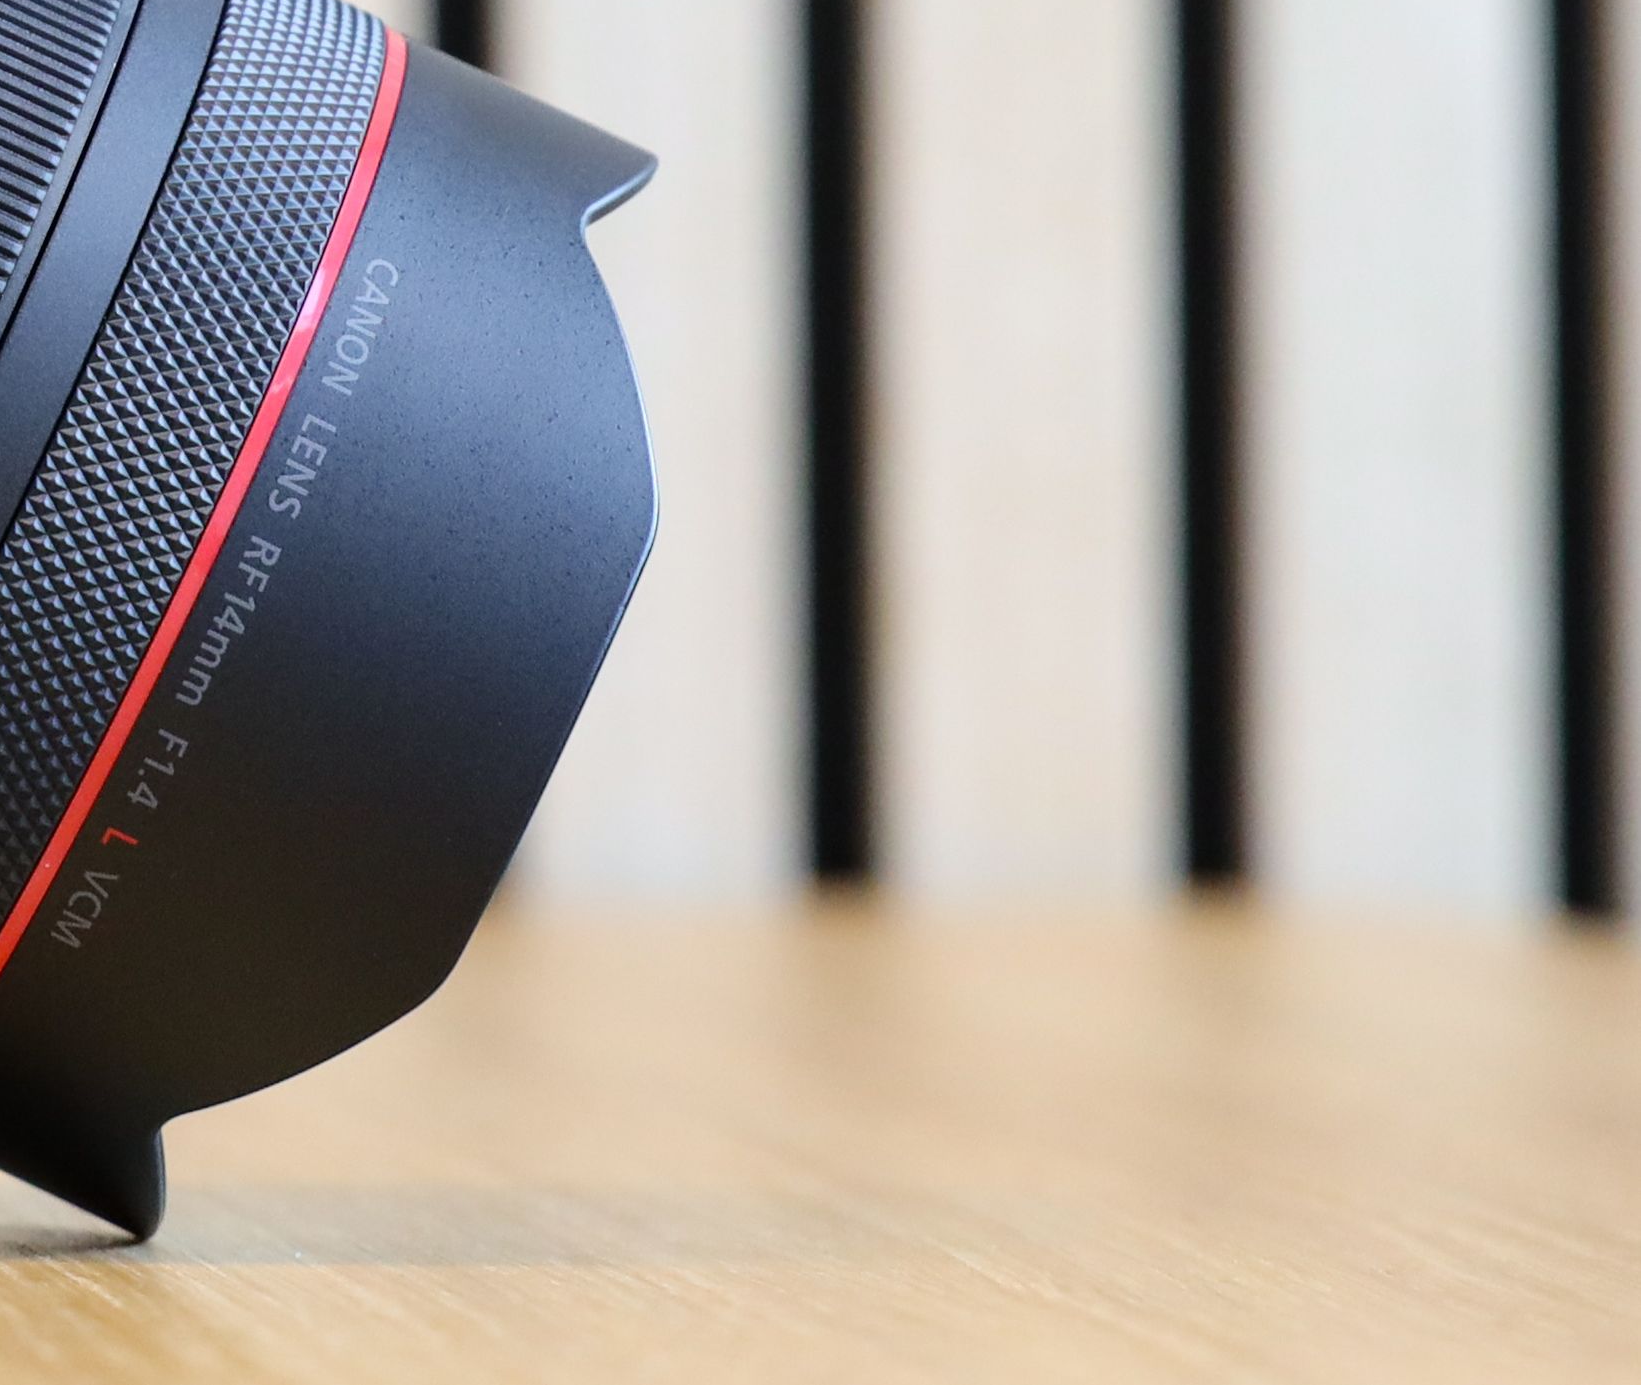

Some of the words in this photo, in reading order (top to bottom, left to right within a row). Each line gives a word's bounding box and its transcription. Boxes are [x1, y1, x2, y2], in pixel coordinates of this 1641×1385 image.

[320, 257, 399, 396] CANON
[267, 412, 337, 520] LENS
[175, 534, 282, 708] RF14mm
[126, 726, 189, 812] F1.4
[100, 825, 139, 847] L
[50, 868, 120, 949] VCM
